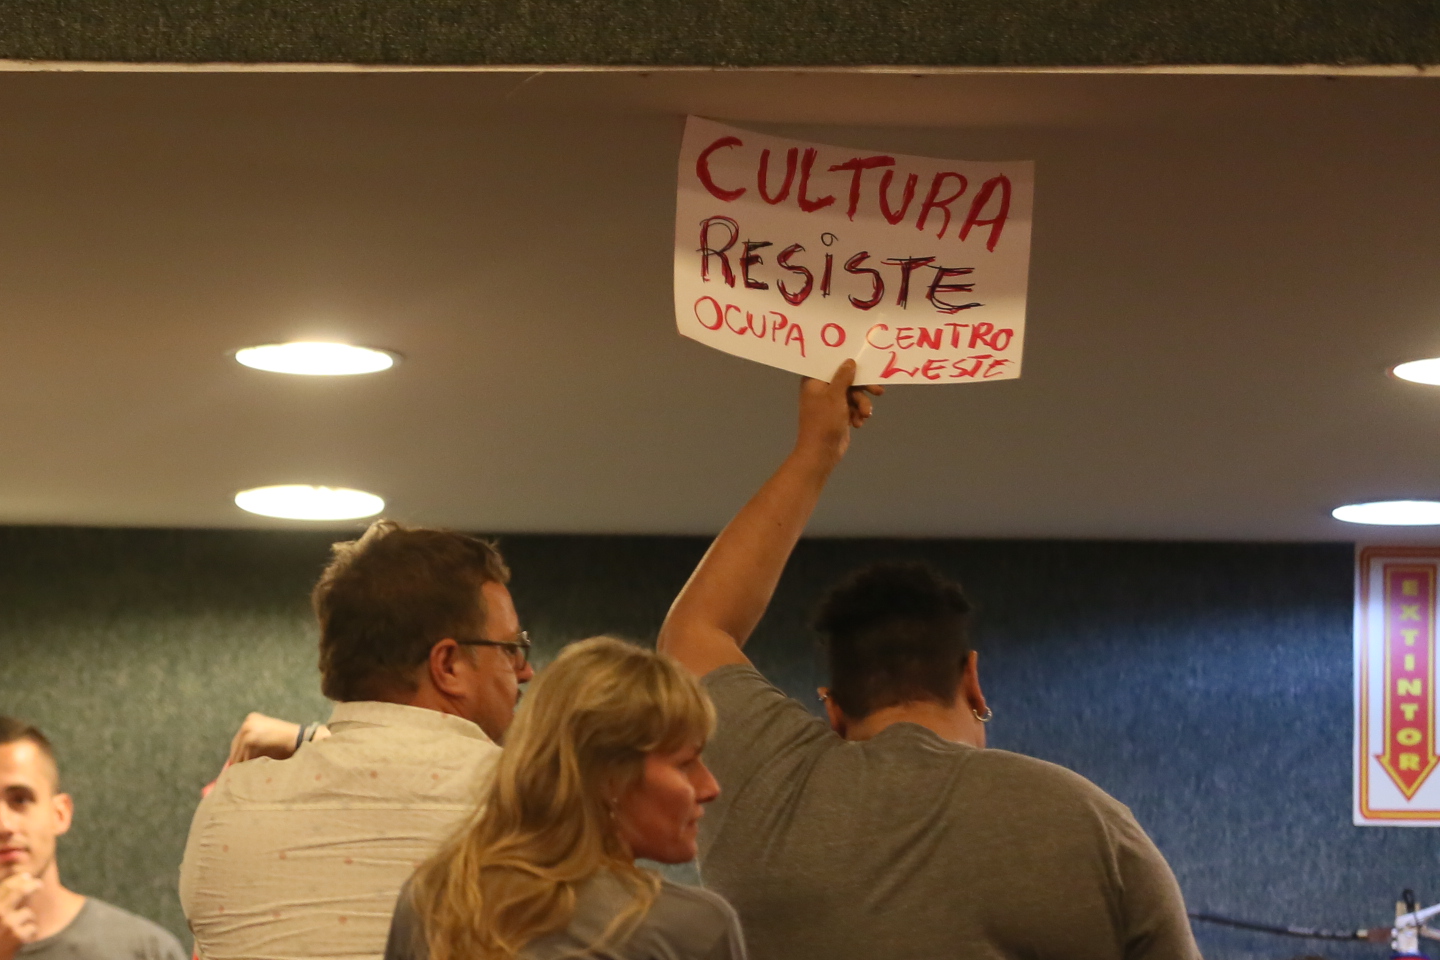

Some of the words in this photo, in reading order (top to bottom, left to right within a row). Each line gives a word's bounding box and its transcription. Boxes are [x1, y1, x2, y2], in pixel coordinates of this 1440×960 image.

[696, 136, 1012, 252] CULTURA
[695, 296, 807, 358] OCUPA
[821, 323, 846, 348] O
[866, 322, 1014, 352] CENTRO
[879, 351, 1015, 380] LESTE
[1397, 579, 1422, 771] EXTINTOR
